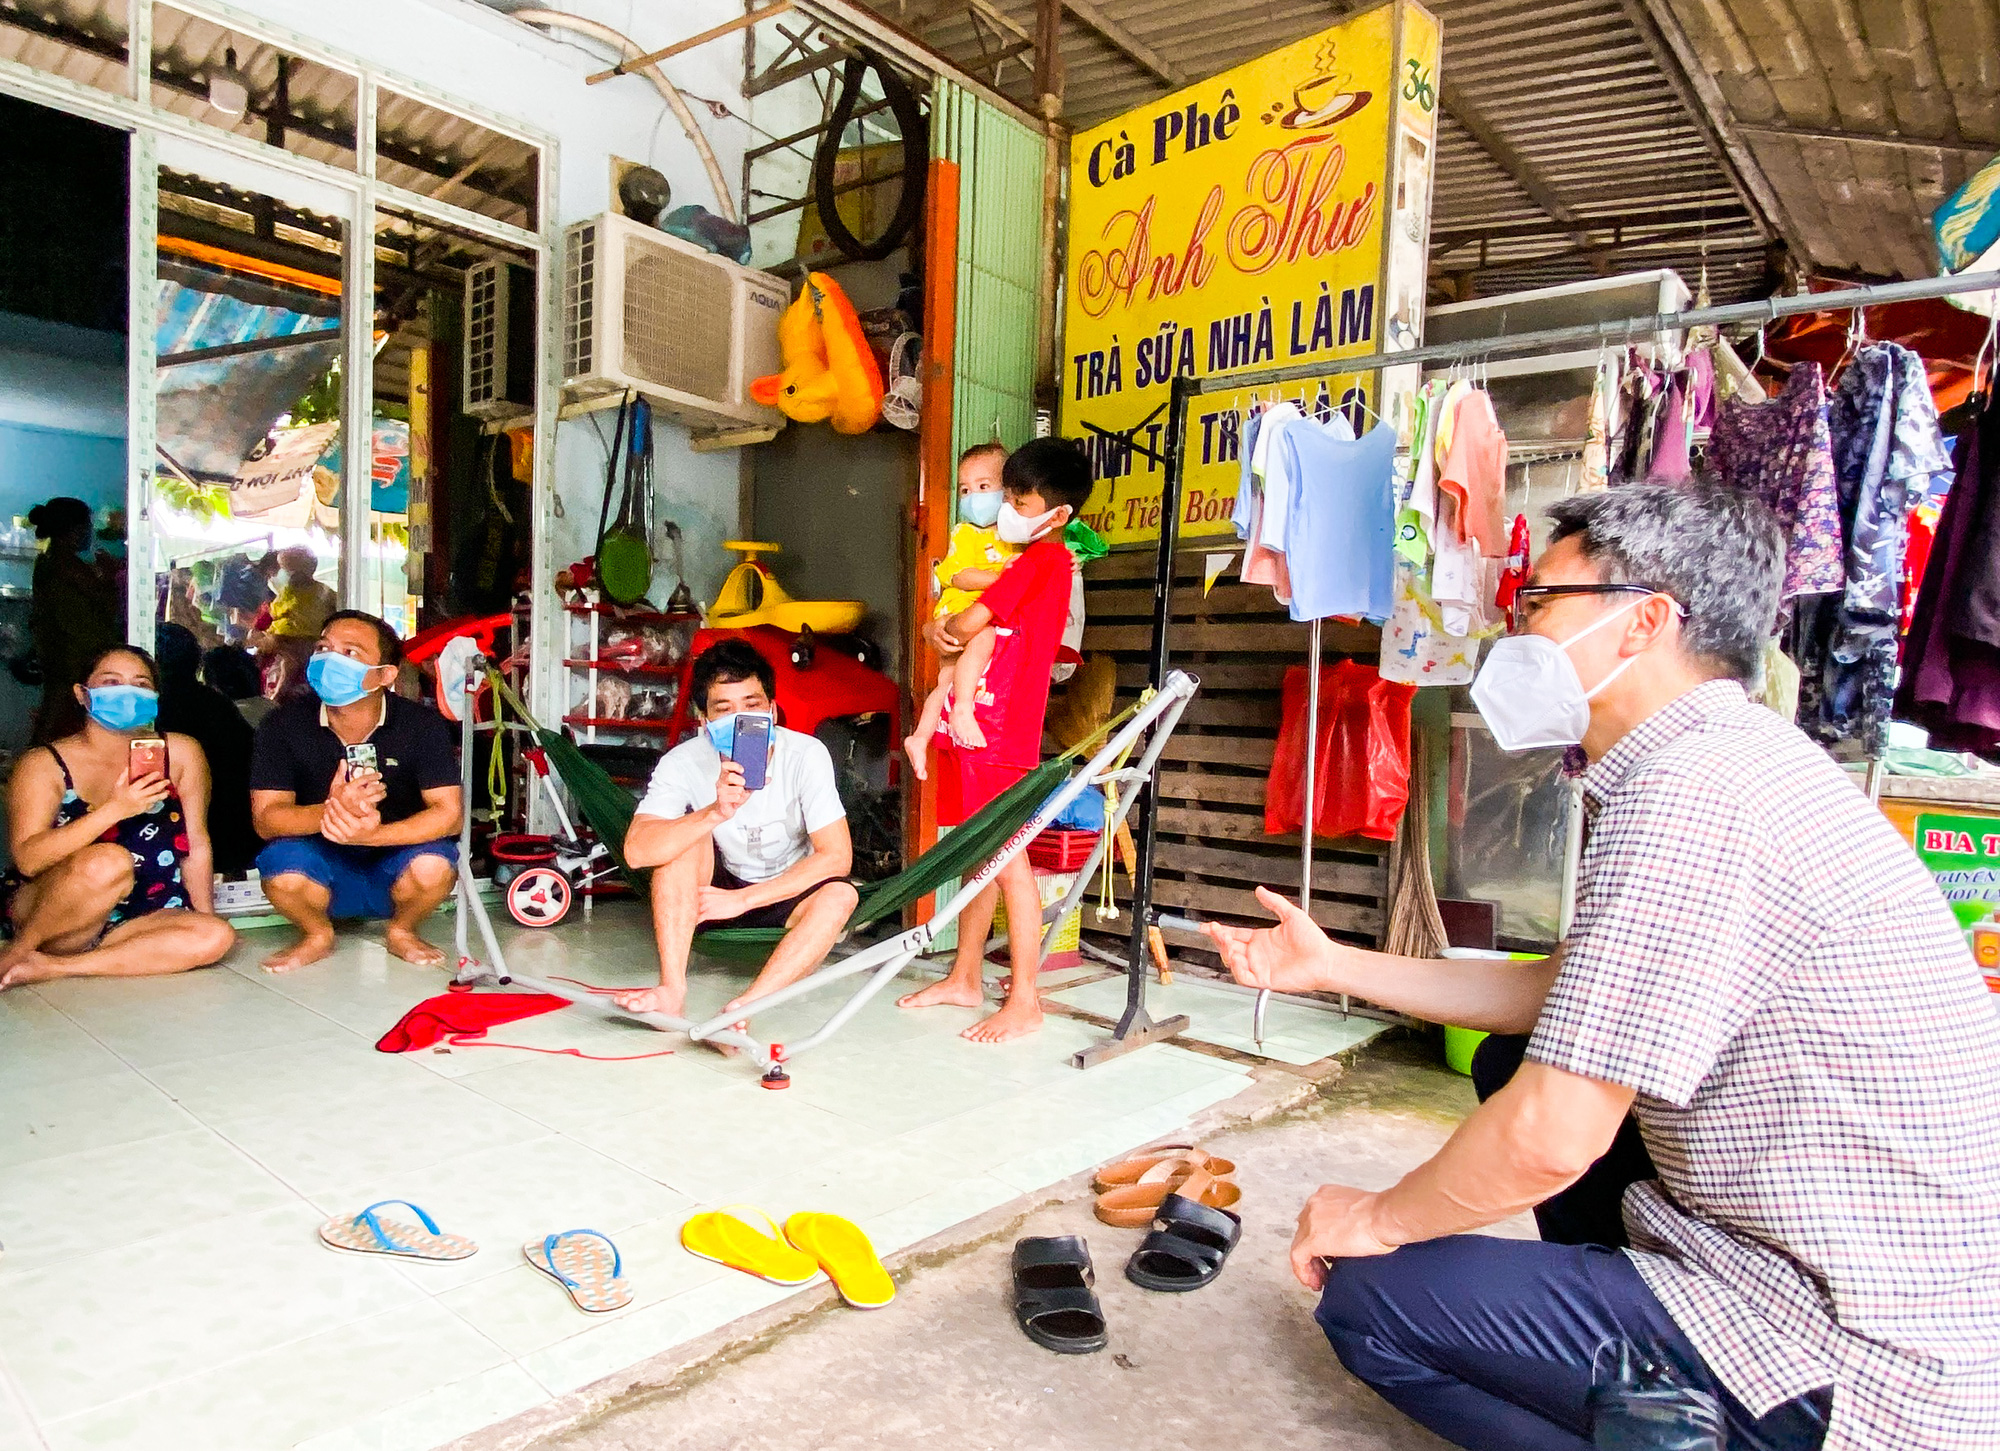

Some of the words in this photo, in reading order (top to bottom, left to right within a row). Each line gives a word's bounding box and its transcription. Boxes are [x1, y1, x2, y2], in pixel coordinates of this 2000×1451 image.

[1088, 130, 1136, 188] Cà
[1151, 88, 1240, 167] Phê
[1078, 184, 1224, 320] Anh
[1226, 132, 1376, 275] Thư
[750, 291, 781, 313] AQUA
[1073, 334, 1122, 401] TRÀ
[1135, 320, 1195, 389] SỮA
[1208, 296, 1274, 373] NHÀ
[1290, 281, 1375, 356] LÀM
[1925, 829, 1976, 854] BIA
